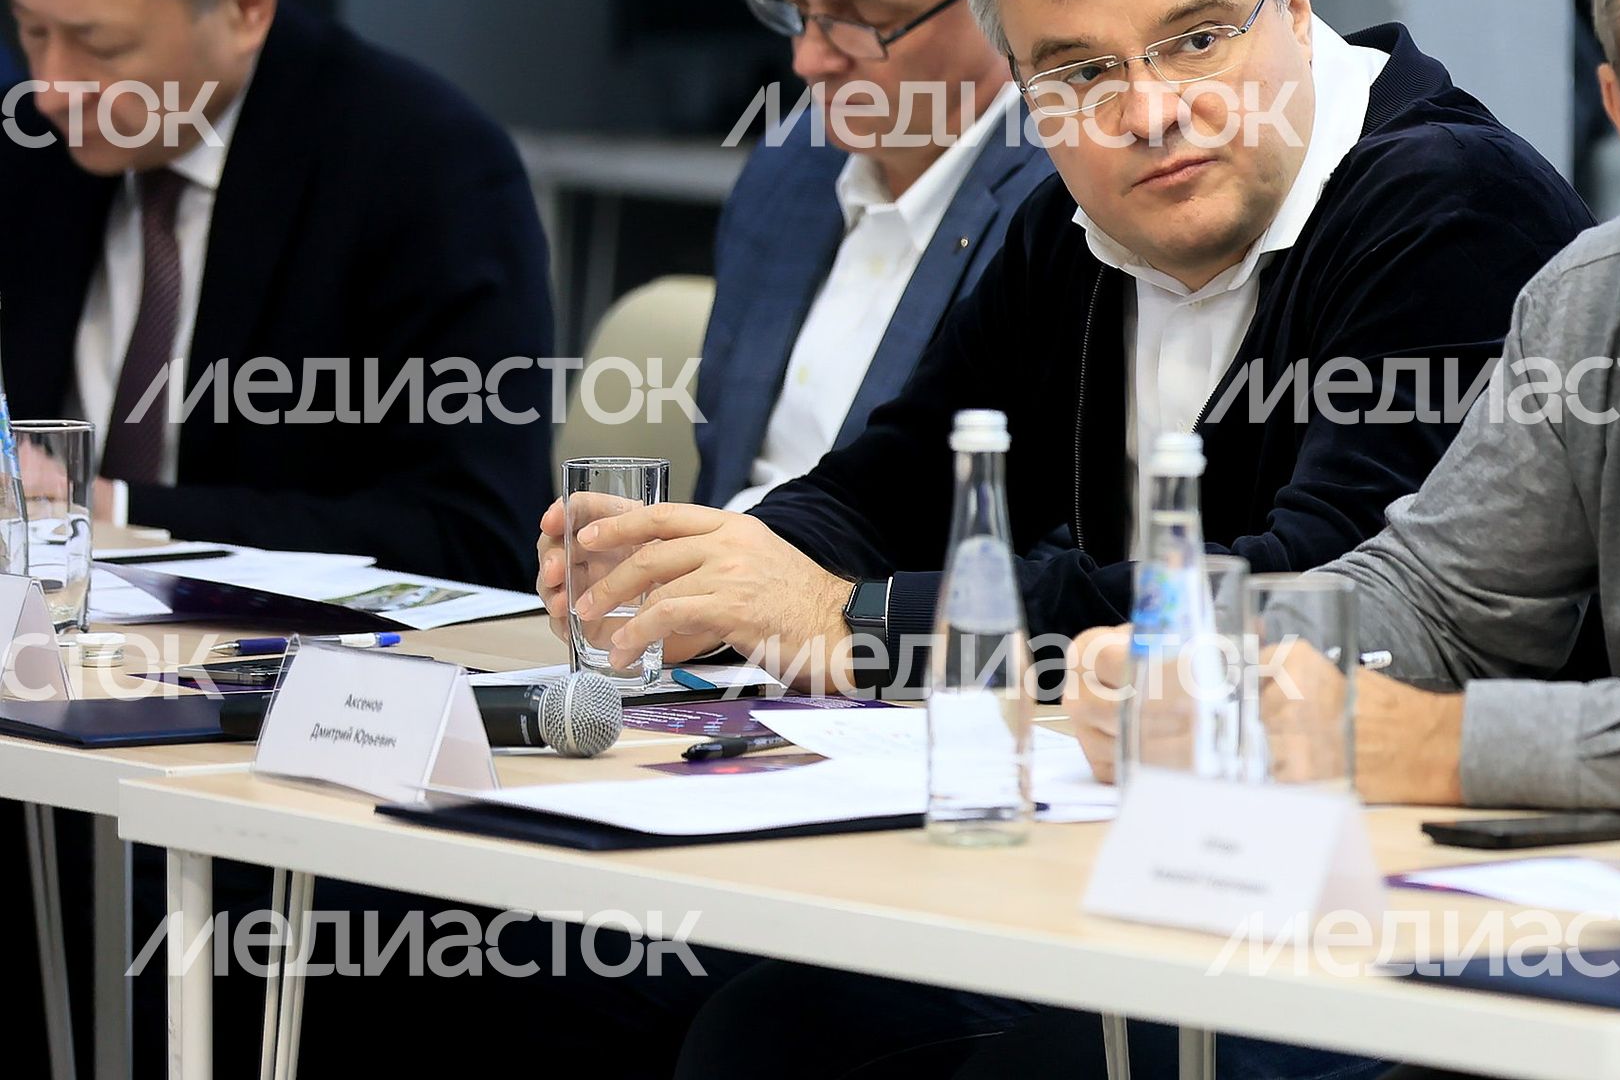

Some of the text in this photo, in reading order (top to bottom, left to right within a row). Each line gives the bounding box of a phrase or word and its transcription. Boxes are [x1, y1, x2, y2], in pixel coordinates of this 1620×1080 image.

[344, 693, 383, 713] Аксенов
[310, 723, 397, 748] Дмитрий Юрьевич
